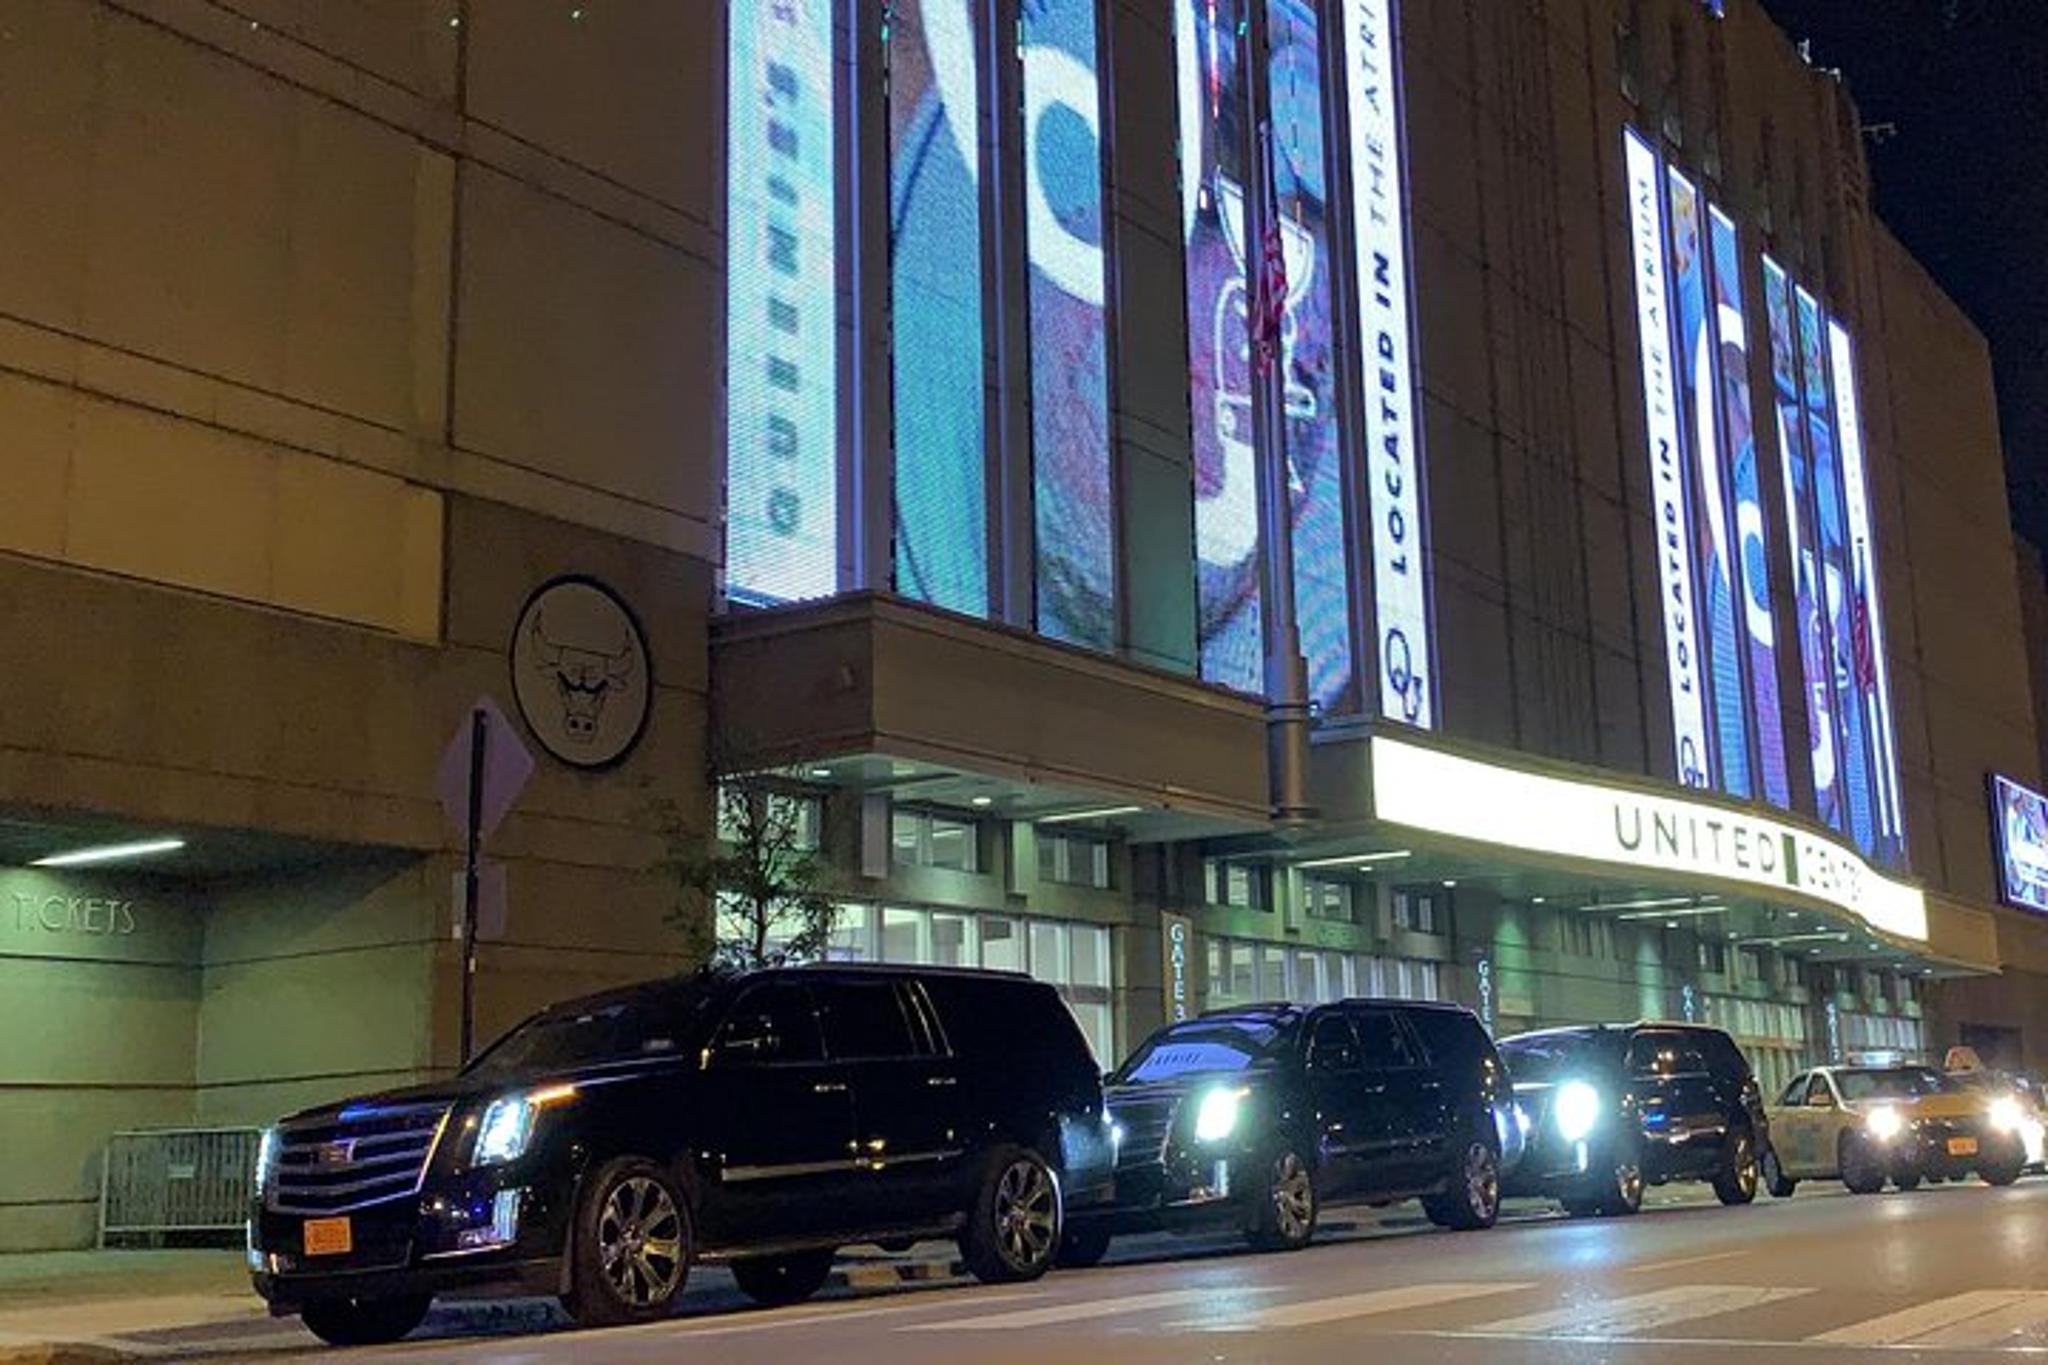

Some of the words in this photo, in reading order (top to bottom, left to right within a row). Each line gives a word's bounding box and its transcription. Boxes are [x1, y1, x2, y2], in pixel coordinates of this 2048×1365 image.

[1365, 133, 1387, 226] THE
[1373, 251, 1391, 308] IN
[1378, 331, 1407, 575] LOCATED
[1659, 437, 1672, 482] IN
[1665, 501, 1690, 692] LOCATED
[1615, 804, 1776, 872] UNITED
[11, 893, 135, 936] TICKETS
[1170, 923, 1185, 1000] GATE
[1478, 960, 1491, 1022] GATE
